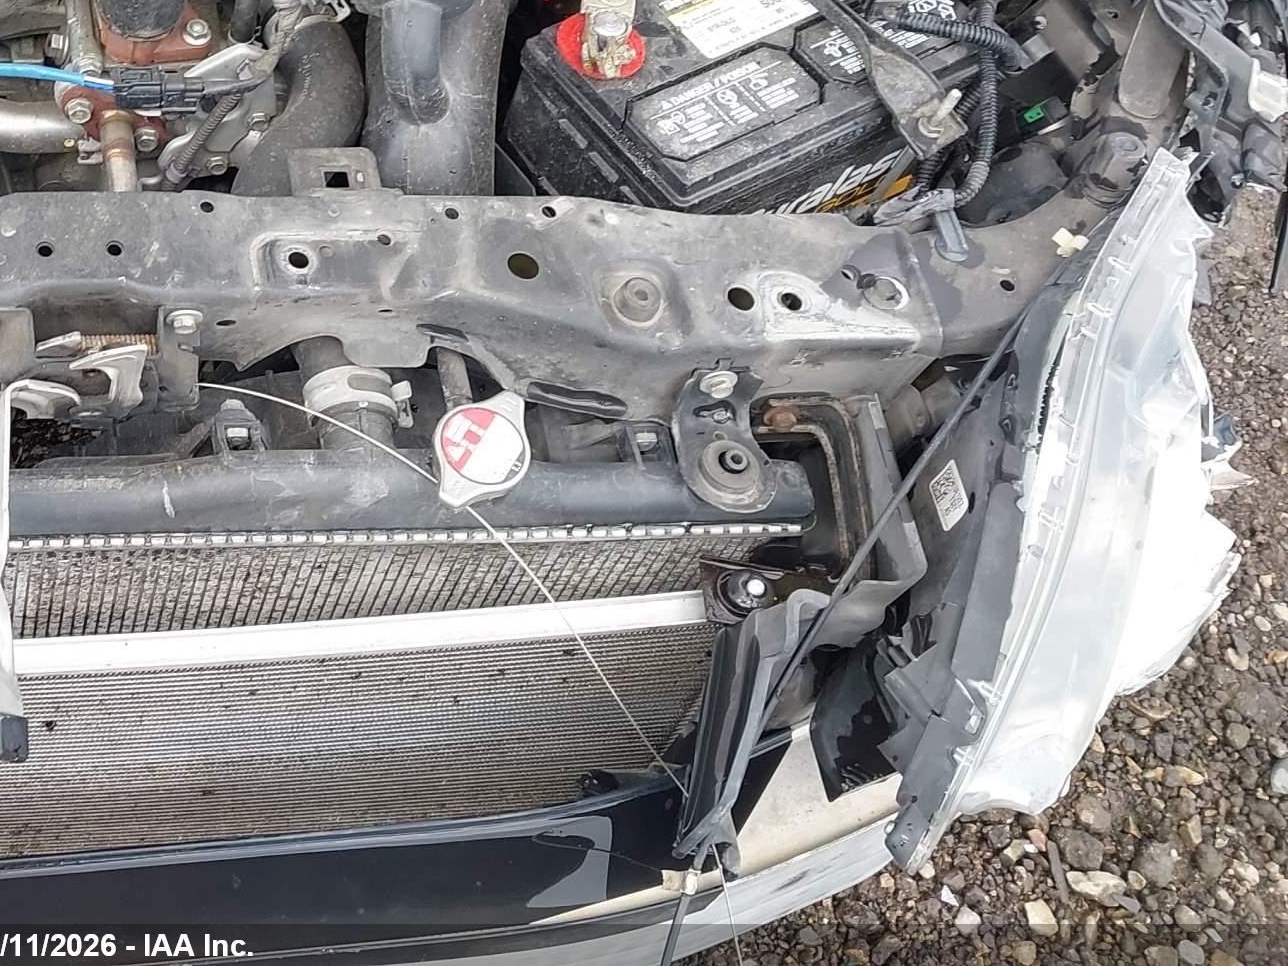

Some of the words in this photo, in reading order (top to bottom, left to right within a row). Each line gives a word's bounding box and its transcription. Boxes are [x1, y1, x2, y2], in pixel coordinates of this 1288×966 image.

[670, 81, 715, 107] DANGER
[722, 61, 761, 85] POISON
[814, 174, 888, 214] GOL
